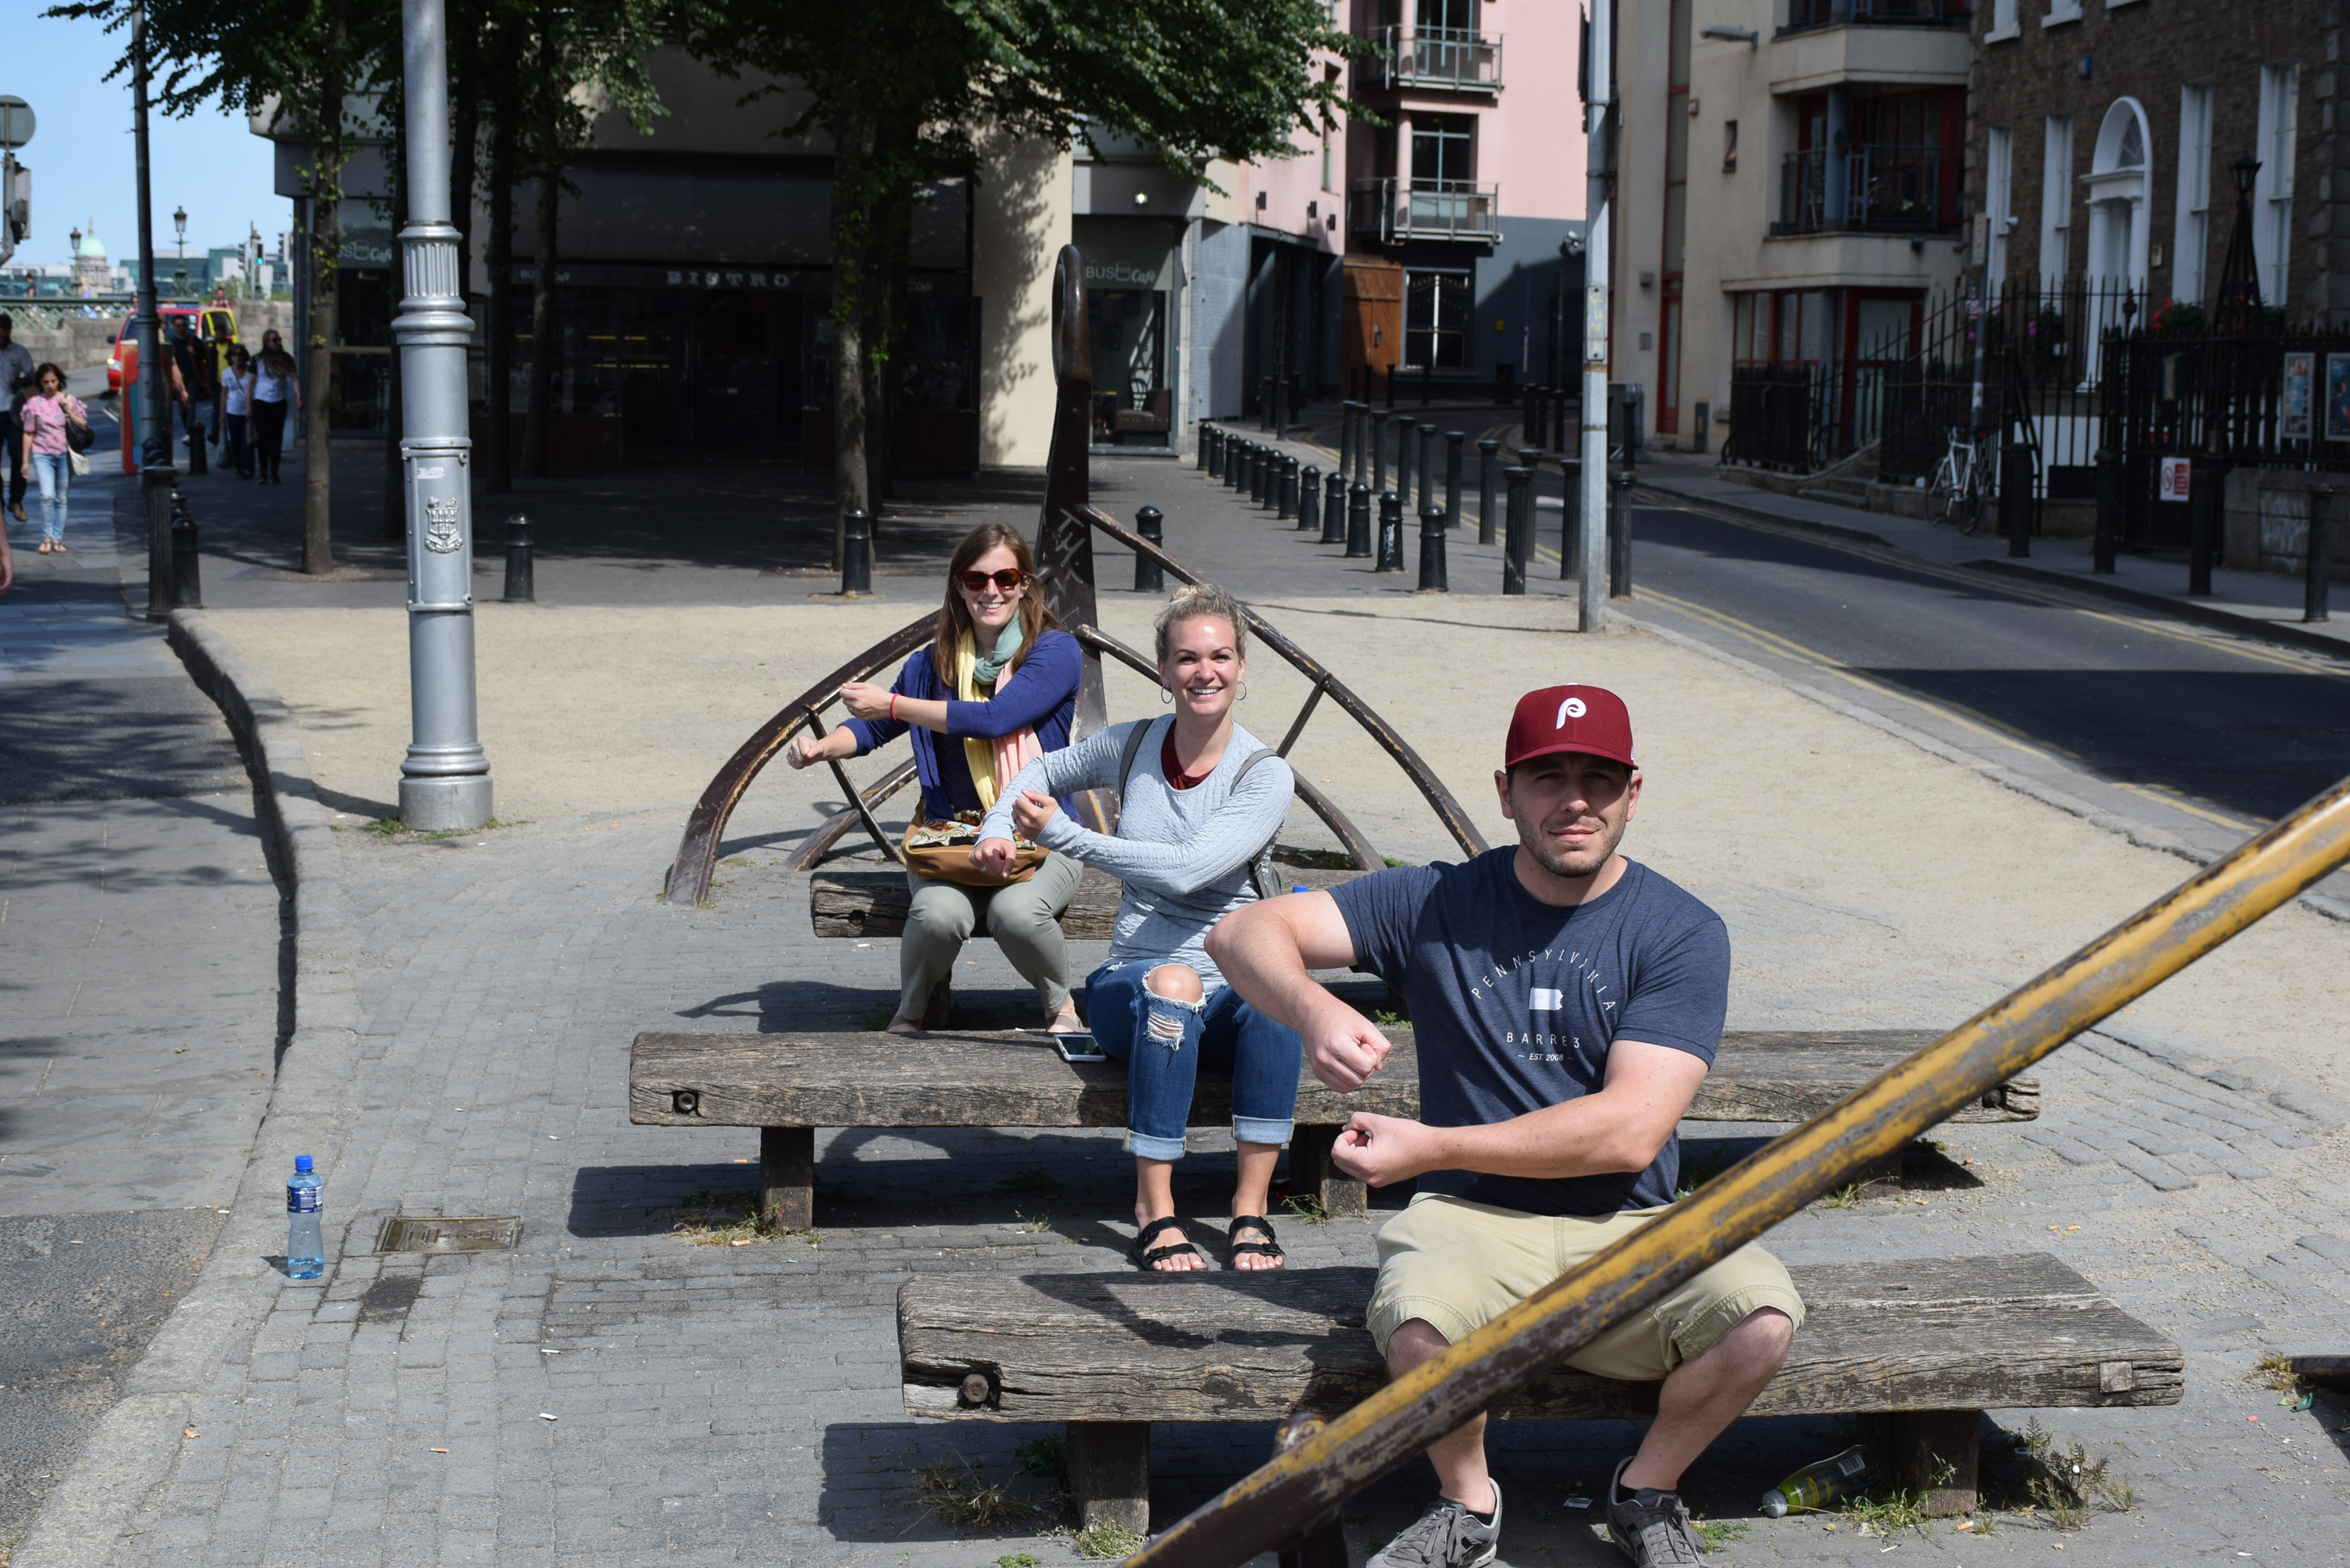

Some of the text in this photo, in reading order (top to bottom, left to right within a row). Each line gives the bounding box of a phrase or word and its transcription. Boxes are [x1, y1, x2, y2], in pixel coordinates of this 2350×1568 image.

[520, 269, 535, 280] BU
[666, 271, 791, 288] BISTRO
[1086, 266, 1115, 279] BUS
[1131, 268, 1157, 285] Café
[1556, 697, 1586, 729] P
[1471, 949, 1616, 1011] PENNSYLVANIA
[1529, 1053, 1564, 1062] EST. 2008
